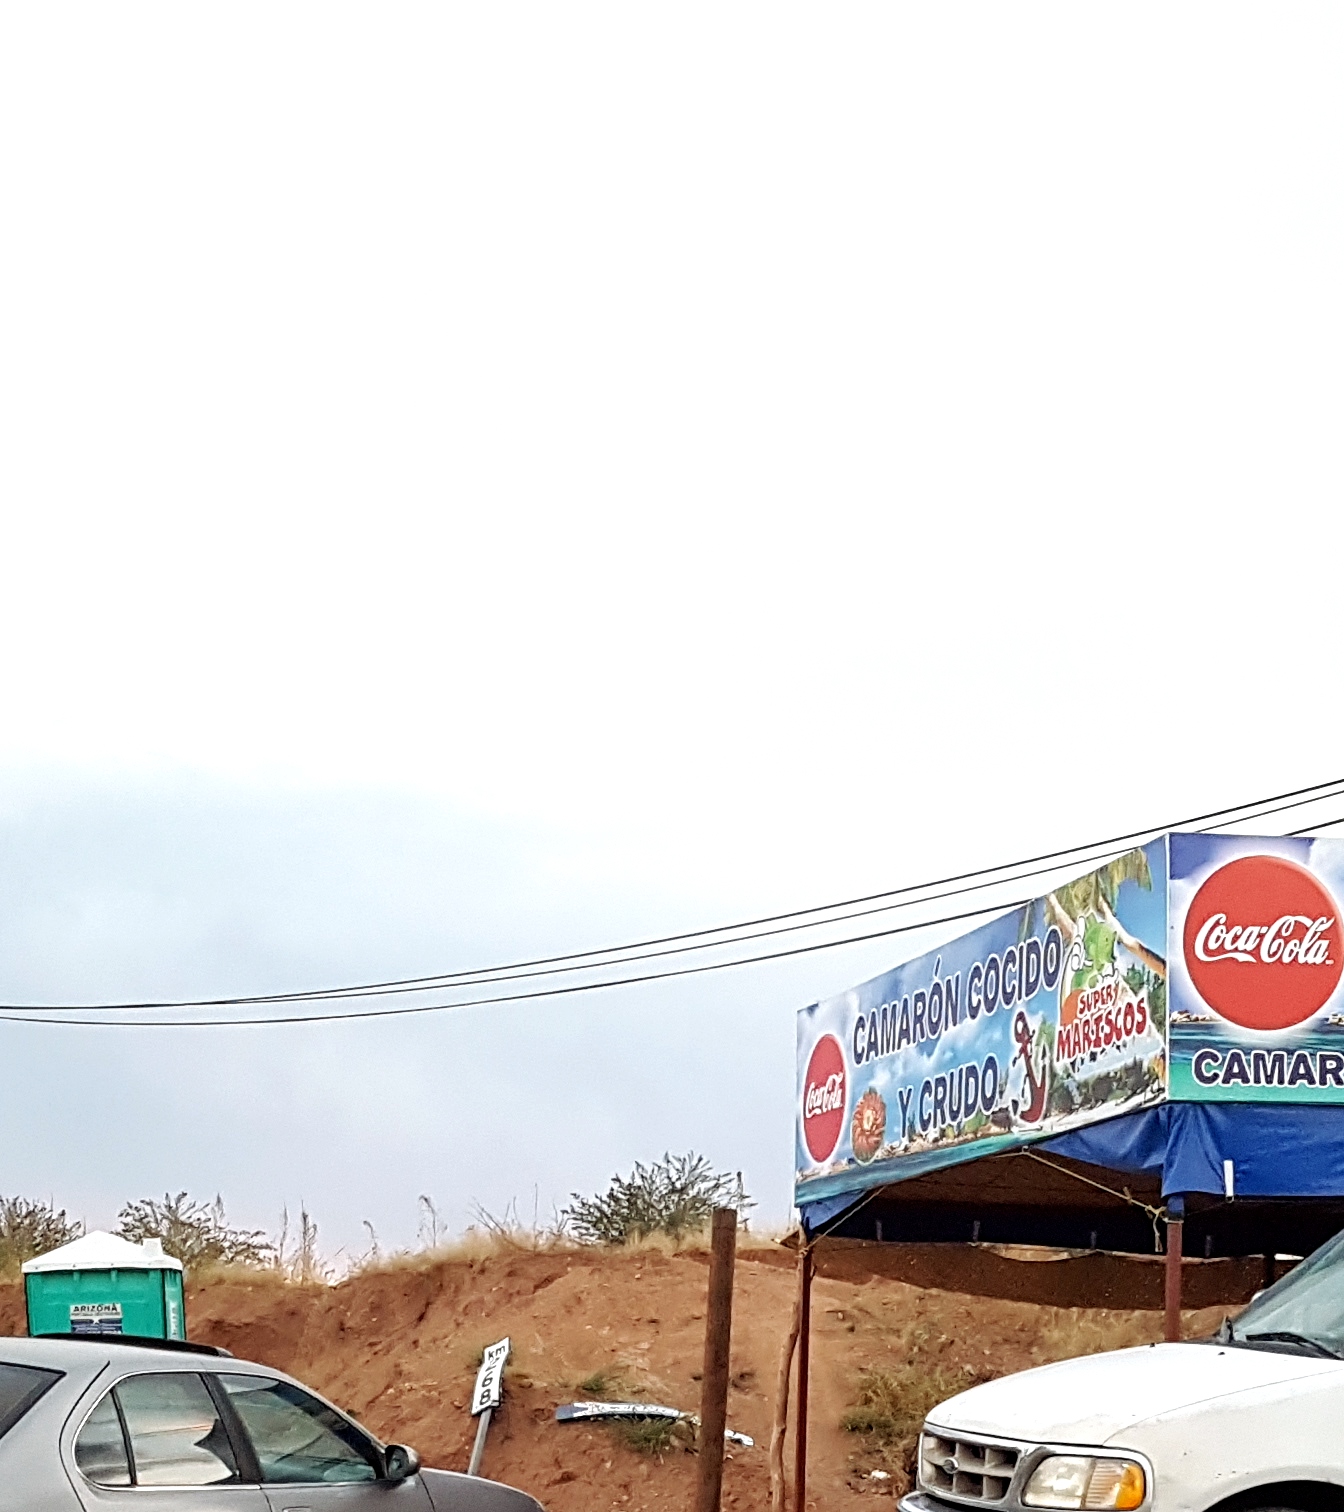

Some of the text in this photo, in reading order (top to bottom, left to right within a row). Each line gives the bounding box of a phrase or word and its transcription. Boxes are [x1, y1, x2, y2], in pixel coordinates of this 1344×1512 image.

[1194, 913, 1335, 964] Coca-Cola
[854, 957, 959, 1064] CAMARÓN
[968, 928, 1061, 1021] COCIDO
[1079, 984, 1113, 1014] SUPER
[1057, 997, 1146, 1062] MARISCOS
[898, 1056, 998, 1138] Y CRUDO
